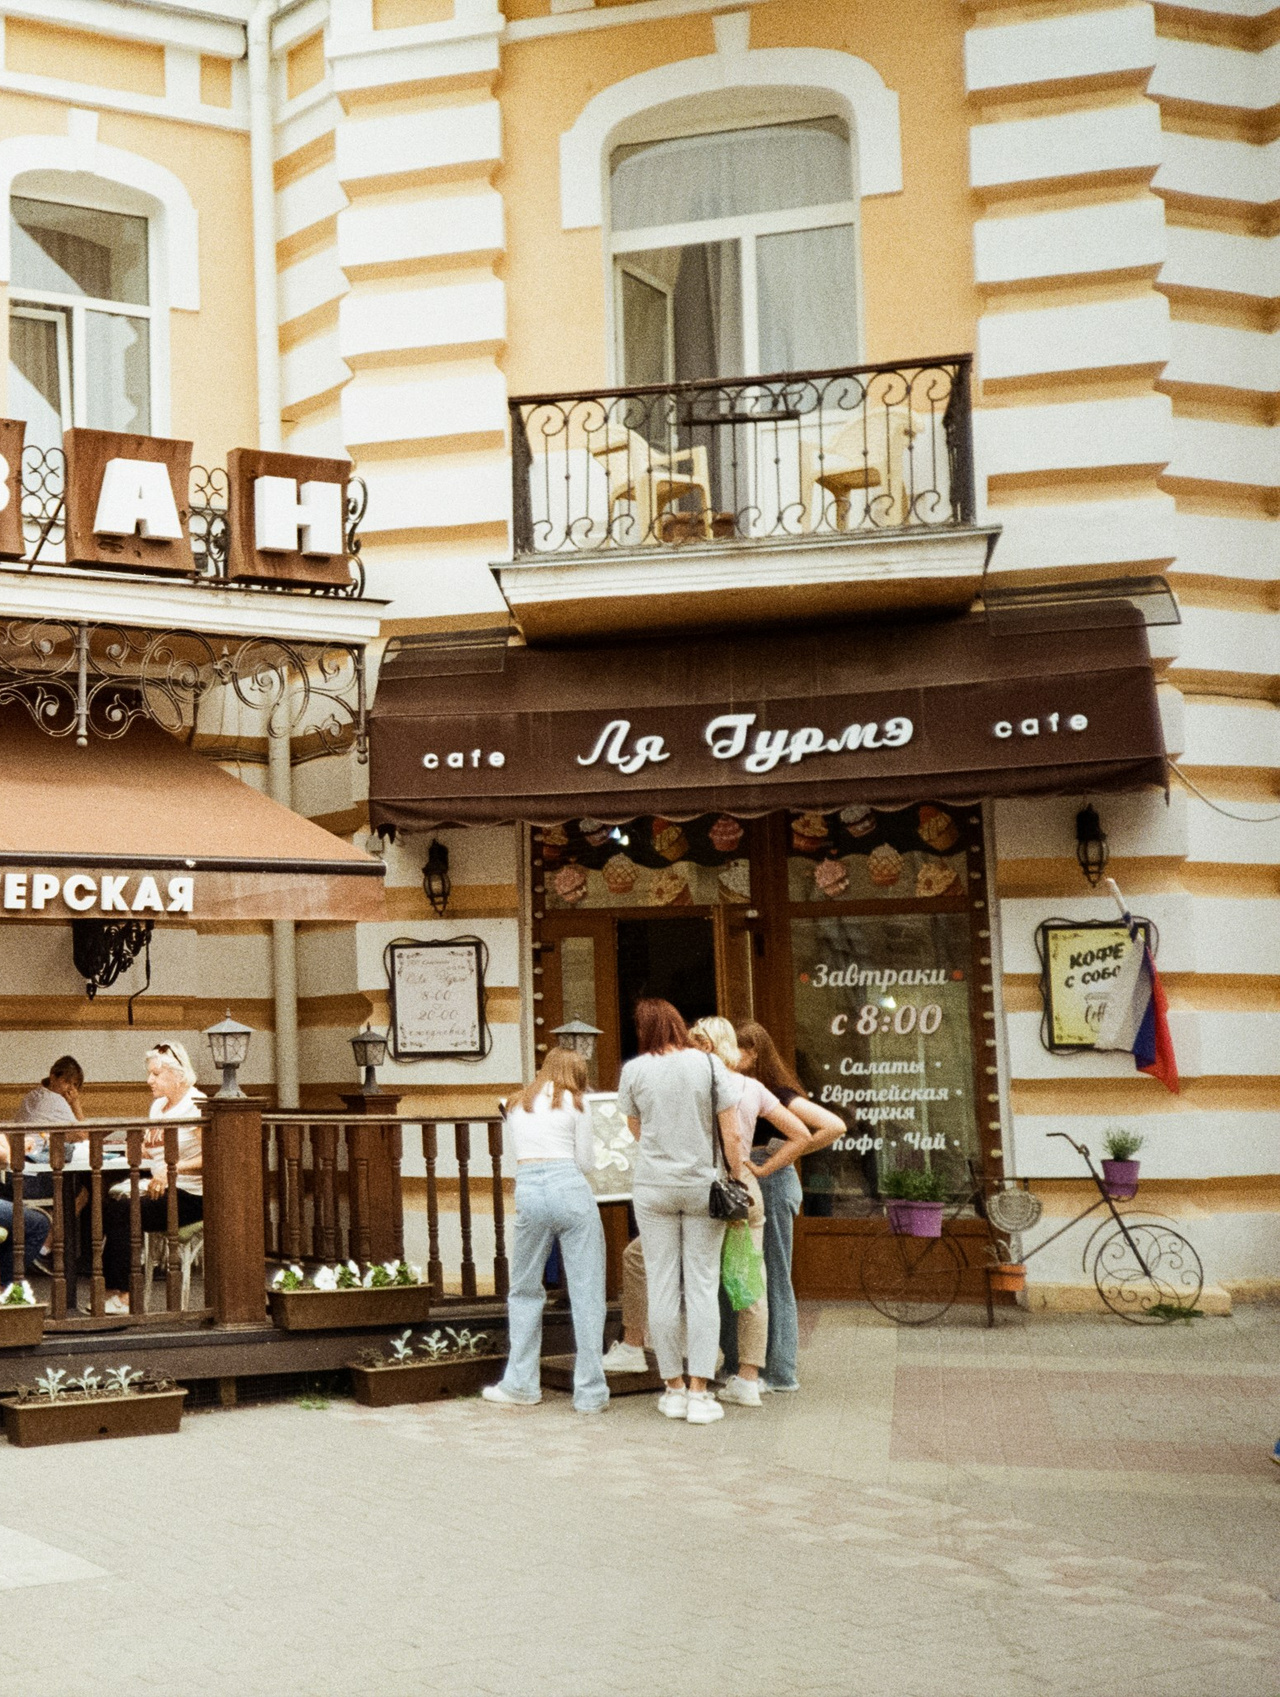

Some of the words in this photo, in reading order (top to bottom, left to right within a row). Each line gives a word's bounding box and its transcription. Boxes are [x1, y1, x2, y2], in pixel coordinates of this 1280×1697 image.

[993, 712, 1089, 739] cafe
[576, 719, 672, 775] Ля
[704, 713, 914, 774] Гурмэ
[422, 748, 506, 770] cafe
[1069, 942, 1125, 969] КОФЕ
[813, 963, 949, 992] Завтраки
[1081, 965, 1121, 985] СОБО
[831, 1013, 849, 1036] с
[856, 1003, 943, 1036] 8:00
[840, 1057, 926, 1076] Салаты
[820, 1084, 950, 1107] Европейская
[855, 1105, 917, 1126] кухня
[903, 1131, 947, 1152] Чай
